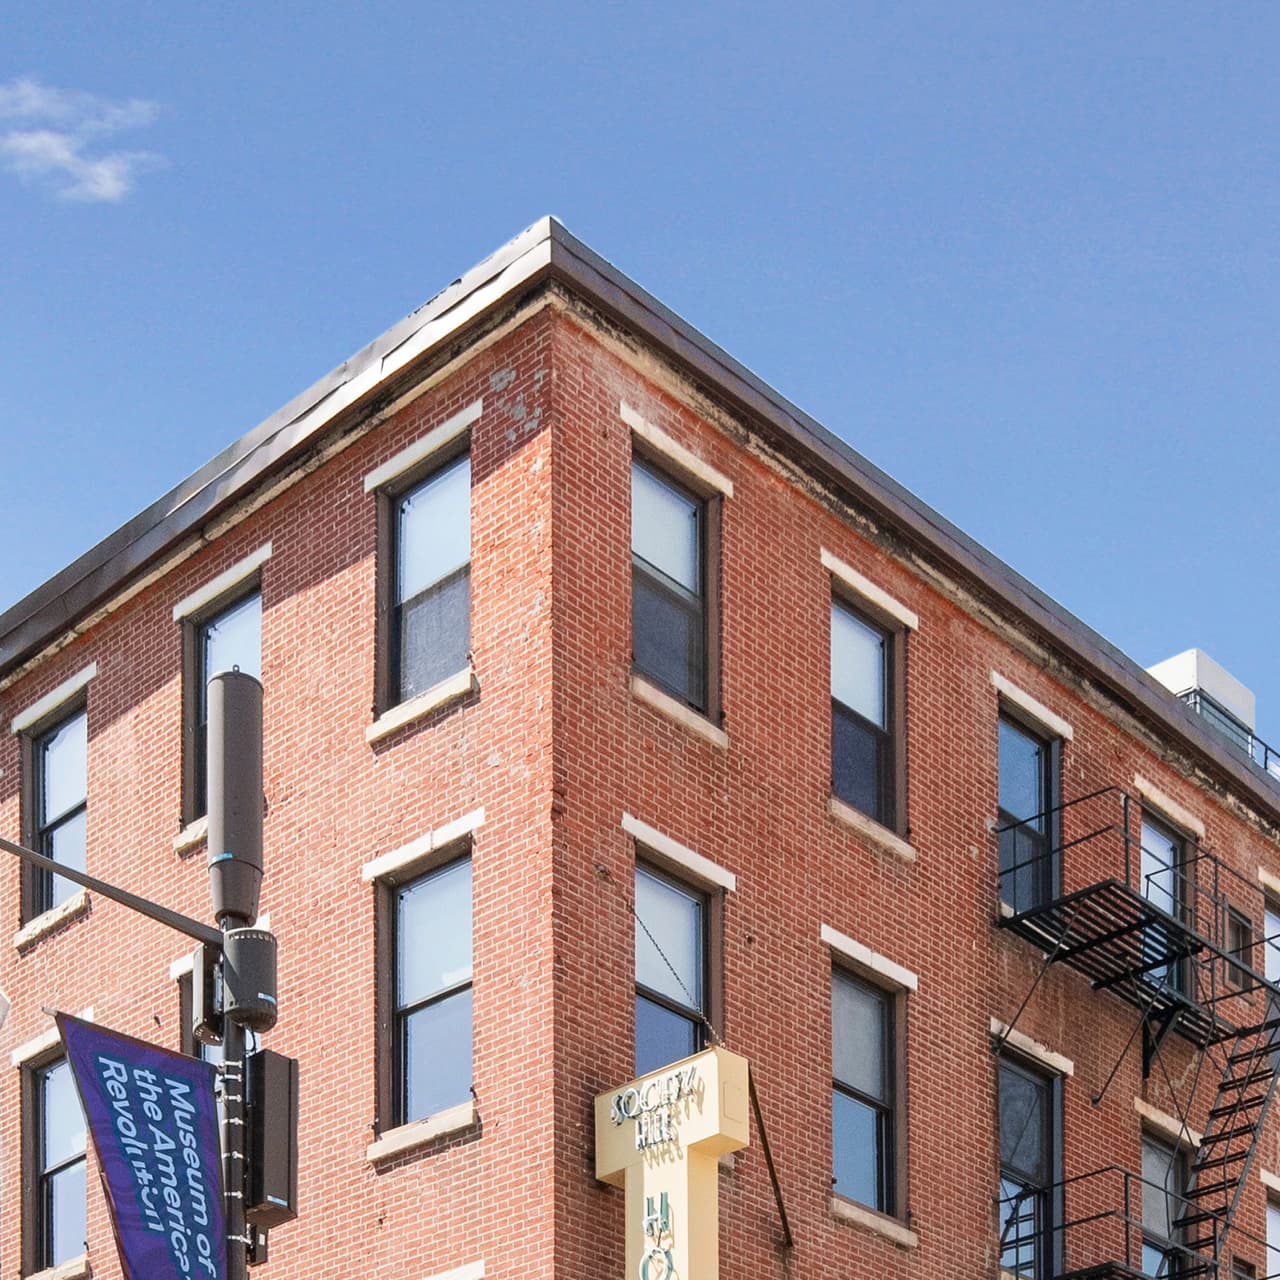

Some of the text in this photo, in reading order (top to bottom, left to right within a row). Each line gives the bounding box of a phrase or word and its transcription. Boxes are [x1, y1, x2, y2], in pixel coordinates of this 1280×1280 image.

[133, 1069, 163, 1122] the
[164, 1078, 216, 1279] Museum of
